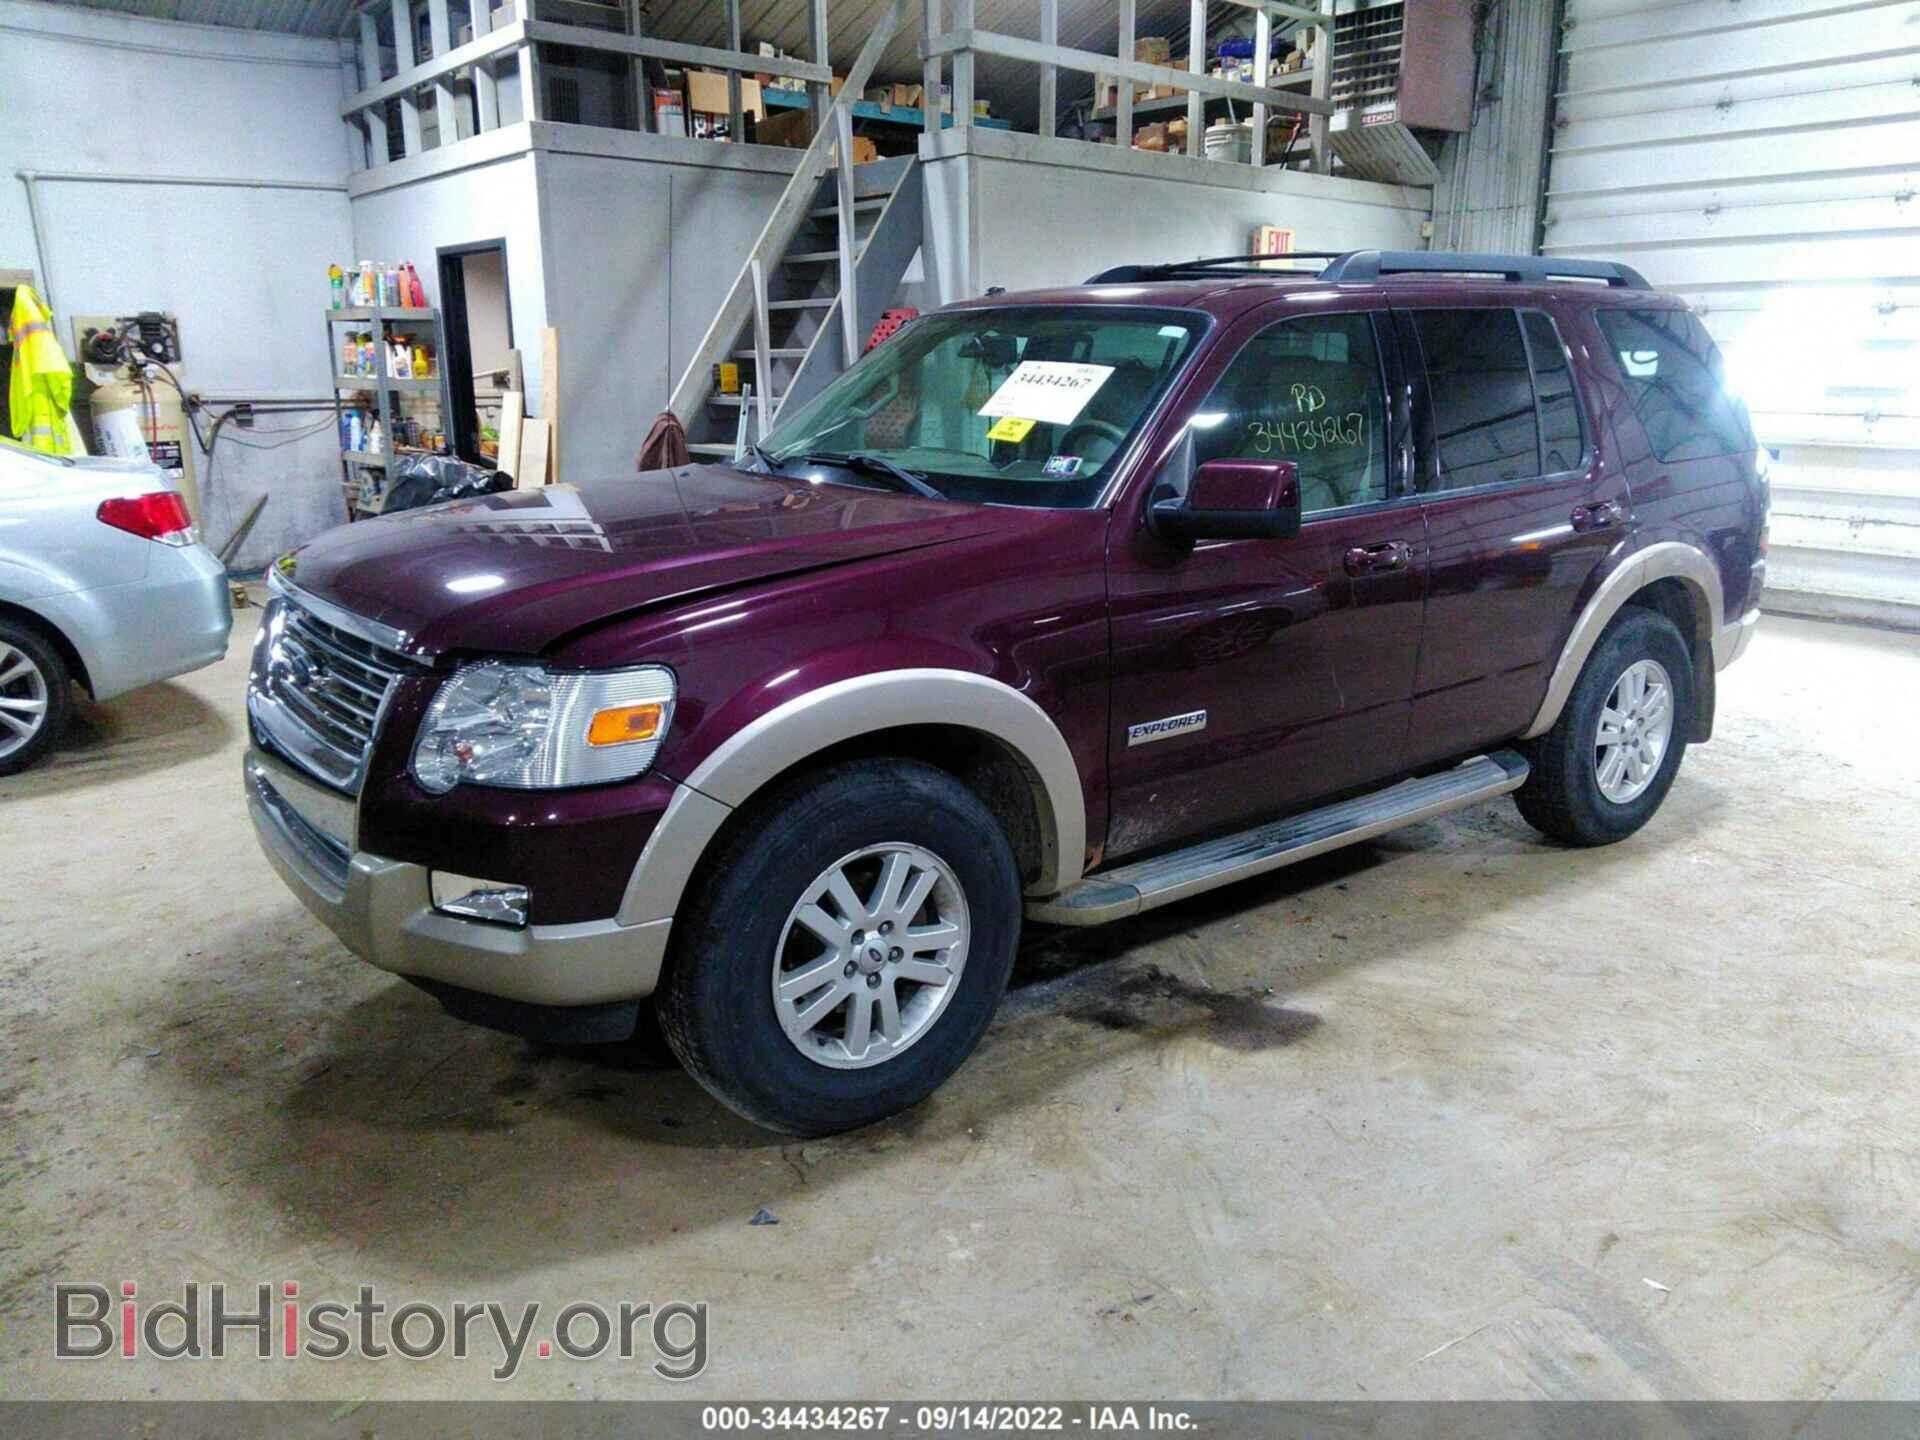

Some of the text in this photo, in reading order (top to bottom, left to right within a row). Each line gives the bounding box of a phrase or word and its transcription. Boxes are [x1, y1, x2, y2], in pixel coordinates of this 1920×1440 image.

[1268, 230, 1290, 254] EXIT
[1291, 383, 1325, 412] RD
[1248, 412, 1364, 453] 34434267
[1131, 712, 1205, 738] EXPLORER
